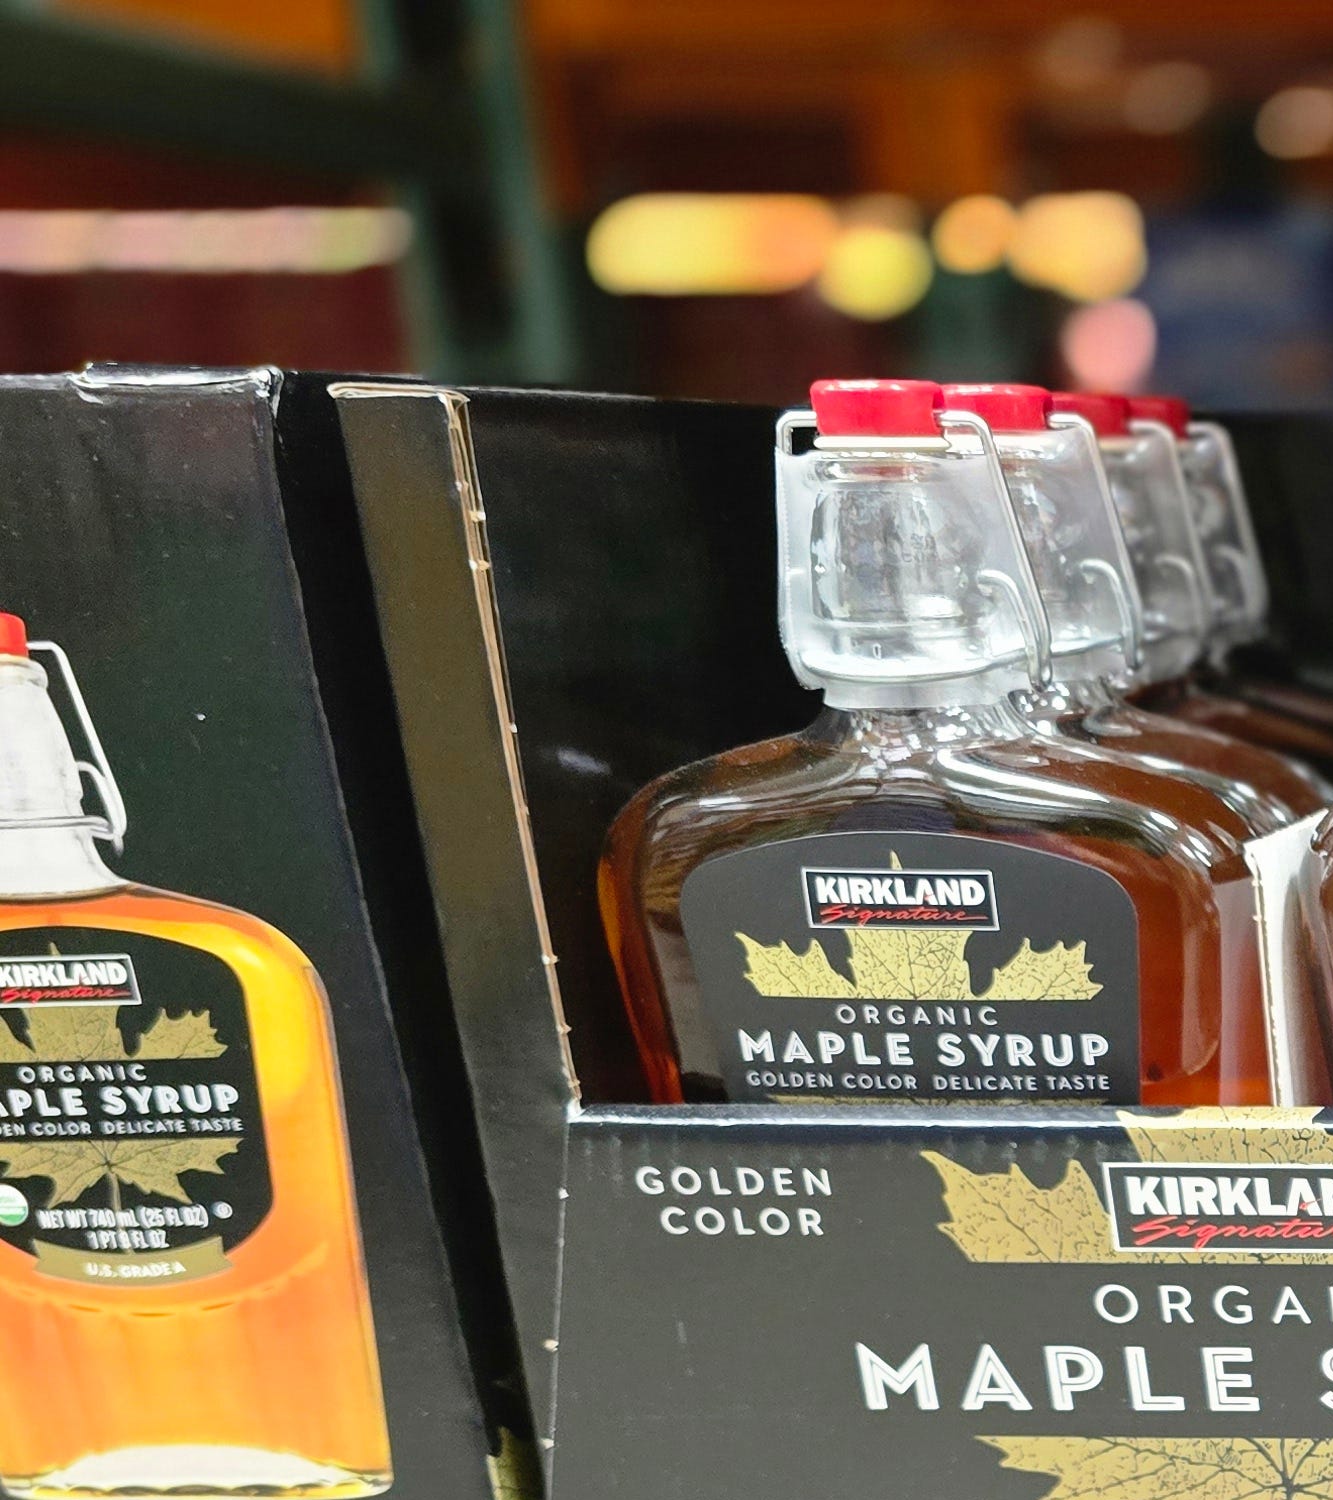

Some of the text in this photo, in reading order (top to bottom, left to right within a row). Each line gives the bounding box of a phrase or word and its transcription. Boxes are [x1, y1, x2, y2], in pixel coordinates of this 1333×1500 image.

[815, 877, 986, 906] KIRKLAND
[820, 905, 987, 926] Signature
[0, 962, 127, 987] KIRKLAND
[836, 1006, 998, 1026] ORGANIC
[739, 1030, 1109, 1067] MAPLE SYRUP
[18, 1064, 146, 1083] ORGANIC
[746, 1070, 1109, 1092] GOLDEN COLOR DELICATE TASTE
[0, 1084, 238, 1116] PLE SYRUP
[30, 1122, 92, 1137] COLOR
[103, 1120, 186, 1135] DELICATE
[191, 1118, 243, 1132] TASTE
[636, 1166, 832, 1197] GOLDEN
[660, 1207, 822, 1237] COLOR
[855, 1344, 1260, 1412] MAPLE
